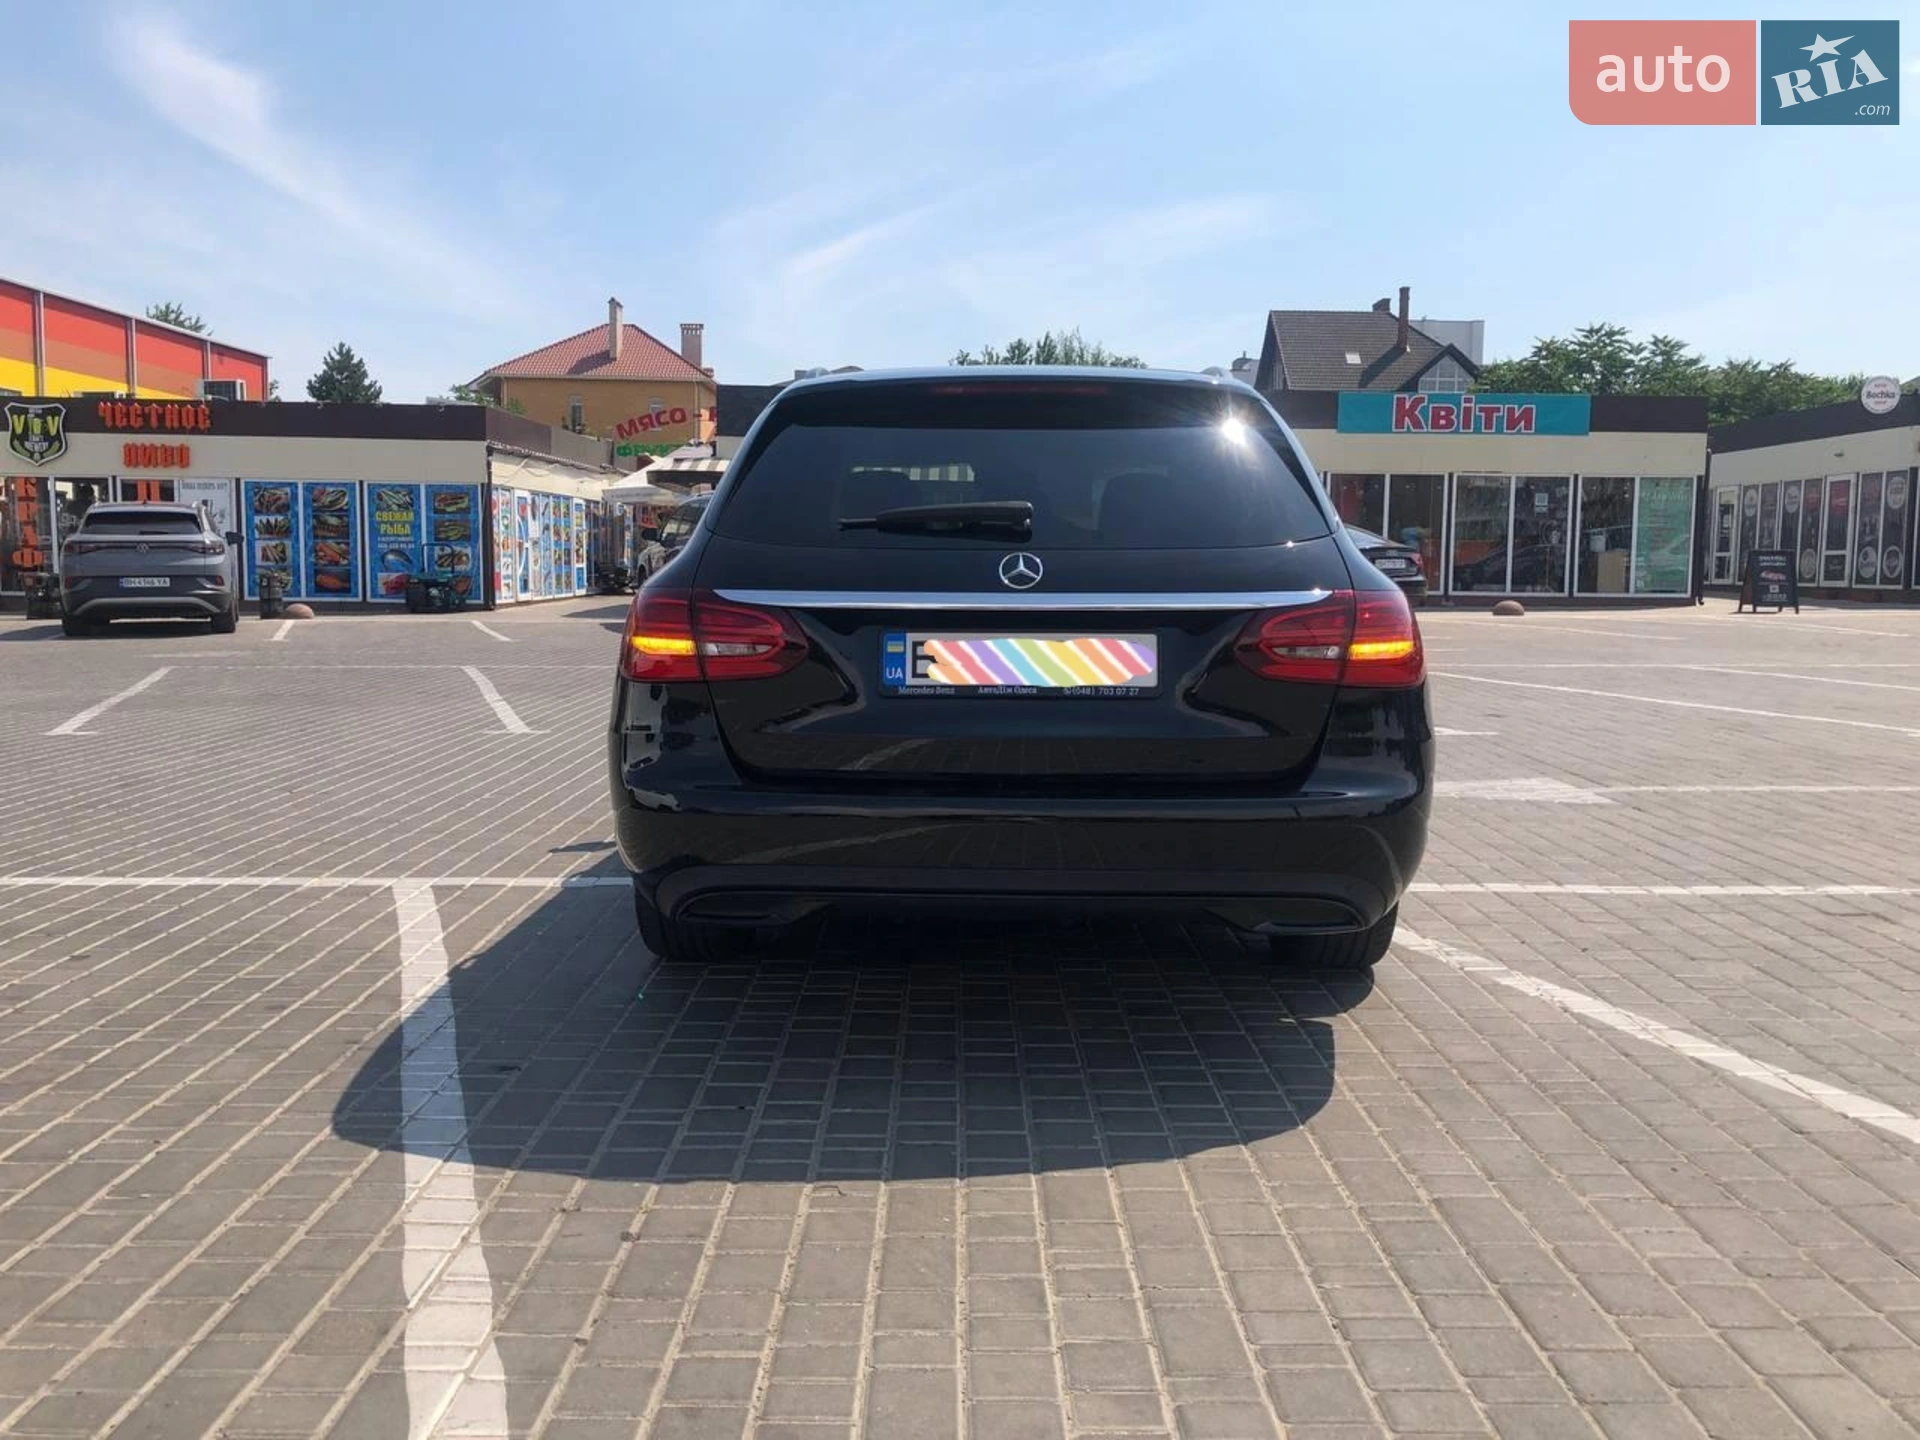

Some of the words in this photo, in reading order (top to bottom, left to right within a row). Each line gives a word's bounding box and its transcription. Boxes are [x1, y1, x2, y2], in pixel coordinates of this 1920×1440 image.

[1866, 390, 1895, 400] Bochka
[97, 401, 212, 432] ЧЕСТНОЕ
[615, 407, 687, 440] МЯСО
[1392, 394, 1536, 433] Квіти
[123, 442, 190, 469] ПИВО
[886, 667, 904, 679] UA
